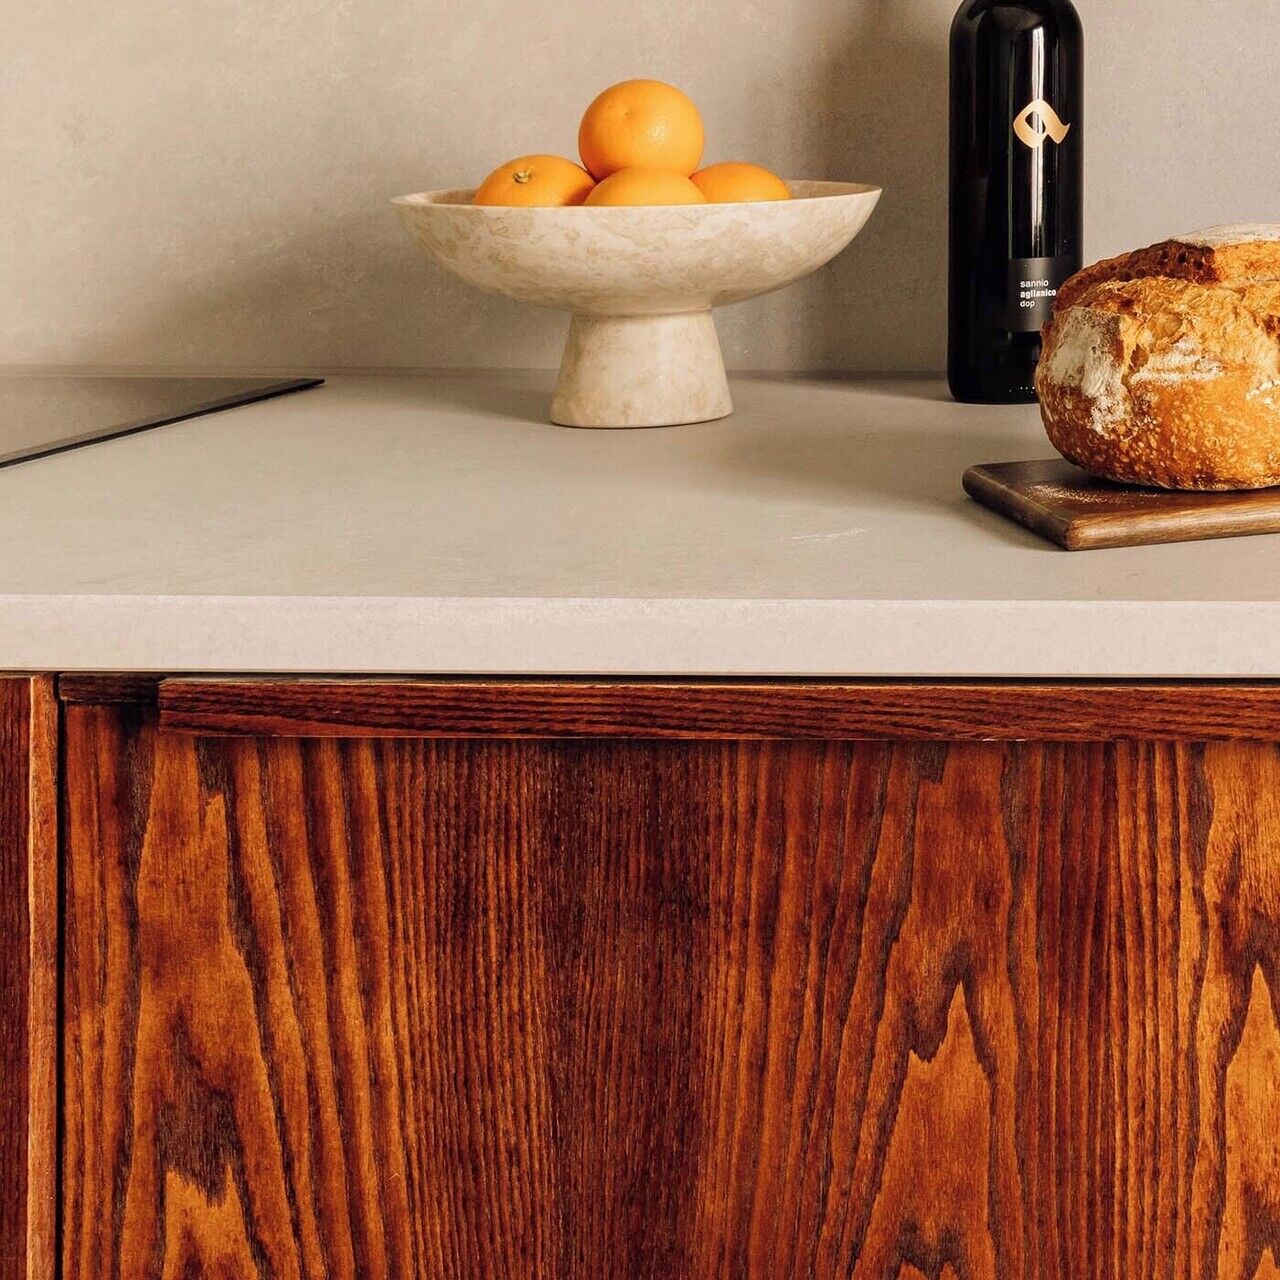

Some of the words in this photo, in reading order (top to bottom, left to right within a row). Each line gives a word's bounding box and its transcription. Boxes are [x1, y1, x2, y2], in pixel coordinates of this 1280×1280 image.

[1020, 279, 1049, 288] sannio
[1020, 289, 1057, 299] aglianico
[1020, 300, 1035, 308] dop
